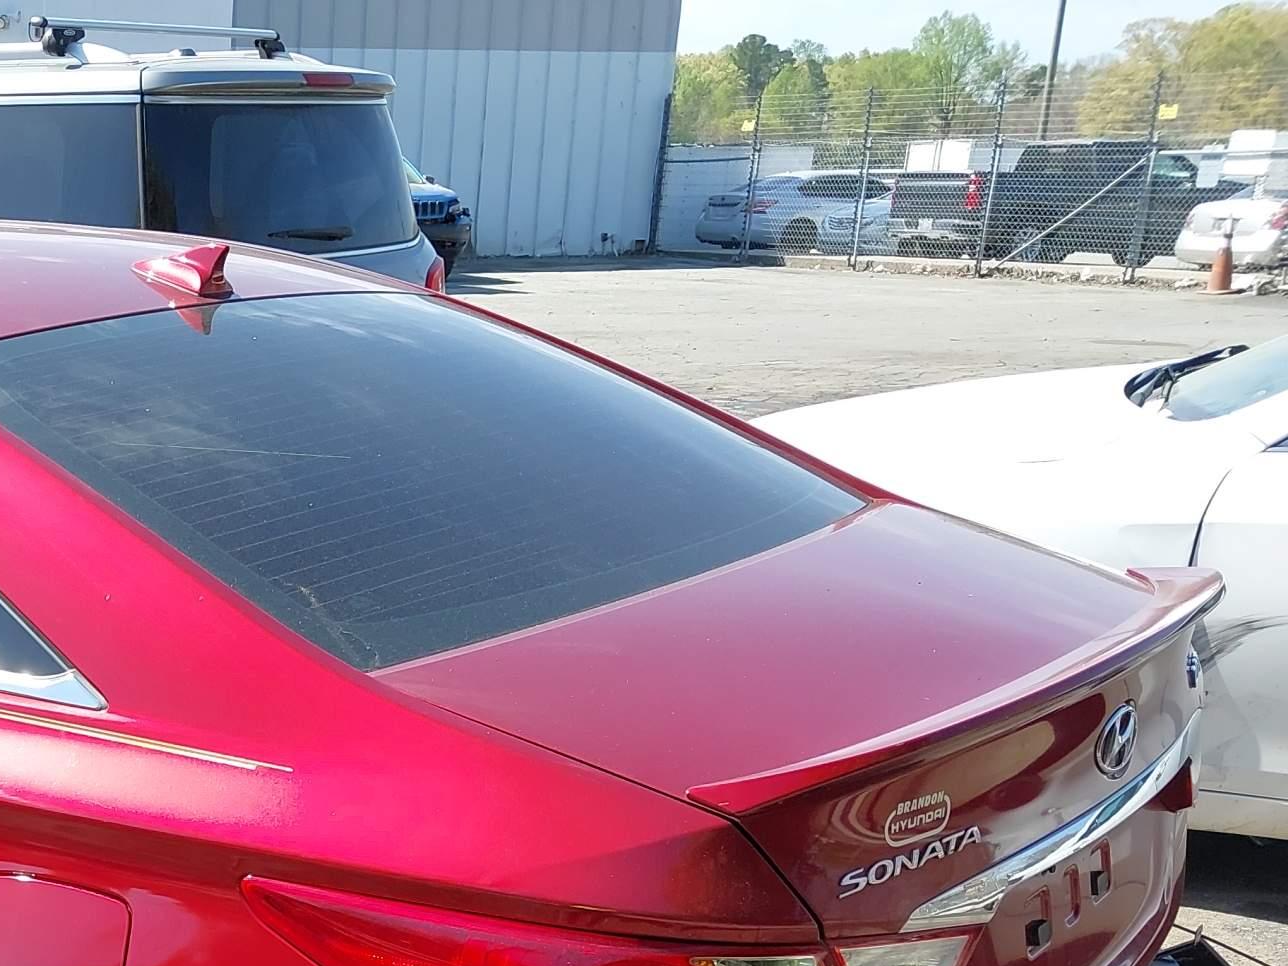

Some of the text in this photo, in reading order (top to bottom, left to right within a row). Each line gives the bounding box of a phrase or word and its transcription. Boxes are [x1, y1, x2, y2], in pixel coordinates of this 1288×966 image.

[896, 790, 945, 816] BRANDON
[891, 806, 946, 834] HYUNDAI
[837, 825, 982, 900] SONATA
